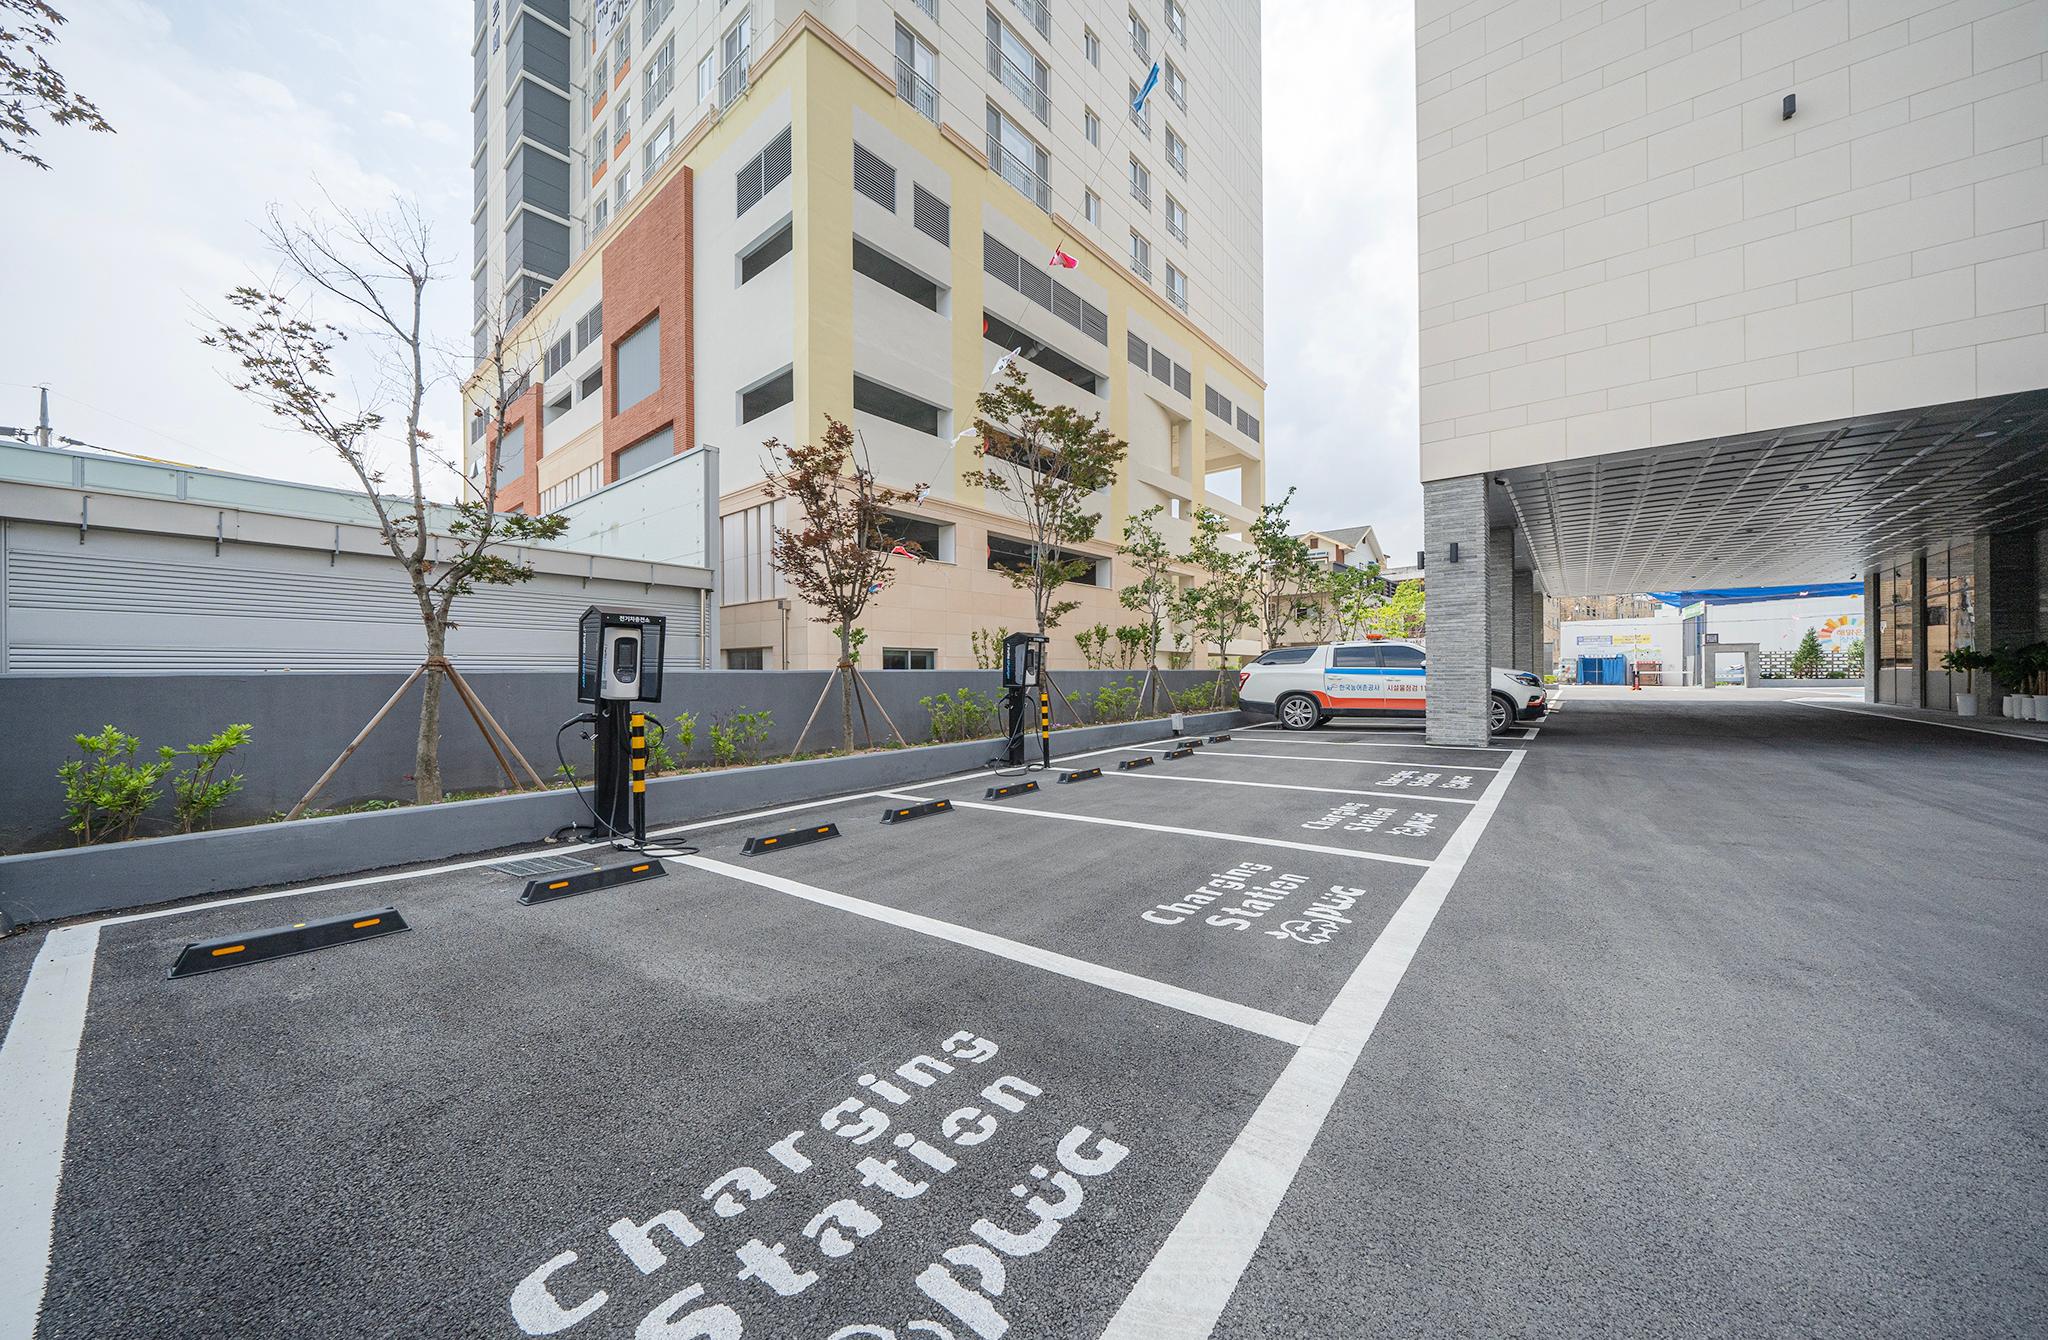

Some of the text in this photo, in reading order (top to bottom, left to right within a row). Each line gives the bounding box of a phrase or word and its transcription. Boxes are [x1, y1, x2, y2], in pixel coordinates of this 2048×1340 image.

[1339, 683, 1380, 692] 한국농어촌공사
[1141, 862, 1273, 926] Charging
[1205, 873, 1310, 931] Station
[510, 1030, 999, 1336] Charging
[634, 1075, 1043, 1340] Station
